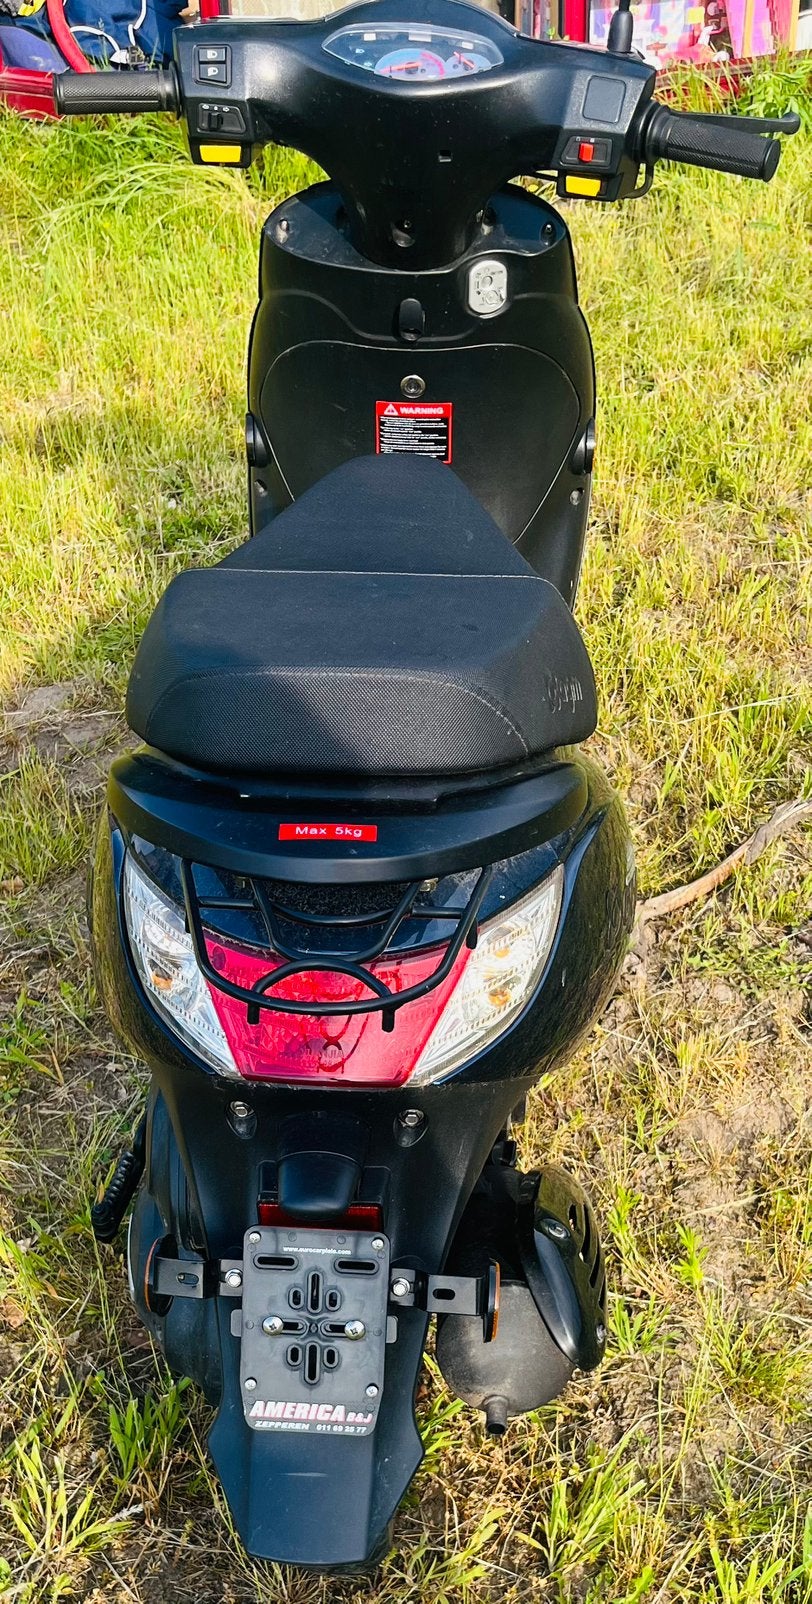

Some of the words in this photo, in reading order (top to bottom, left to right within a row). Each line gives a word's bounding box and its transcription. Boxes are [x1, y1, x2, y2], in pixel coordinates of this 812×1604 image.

[400, 406, 444, 415] WARNING
[295, 826, 327, 835] Max
[335, 826, 362, 838] 5kg
[249, 1400, 346, 1422] AMERICA
[255, 1421, 310, 1431] ZEPPEREN
